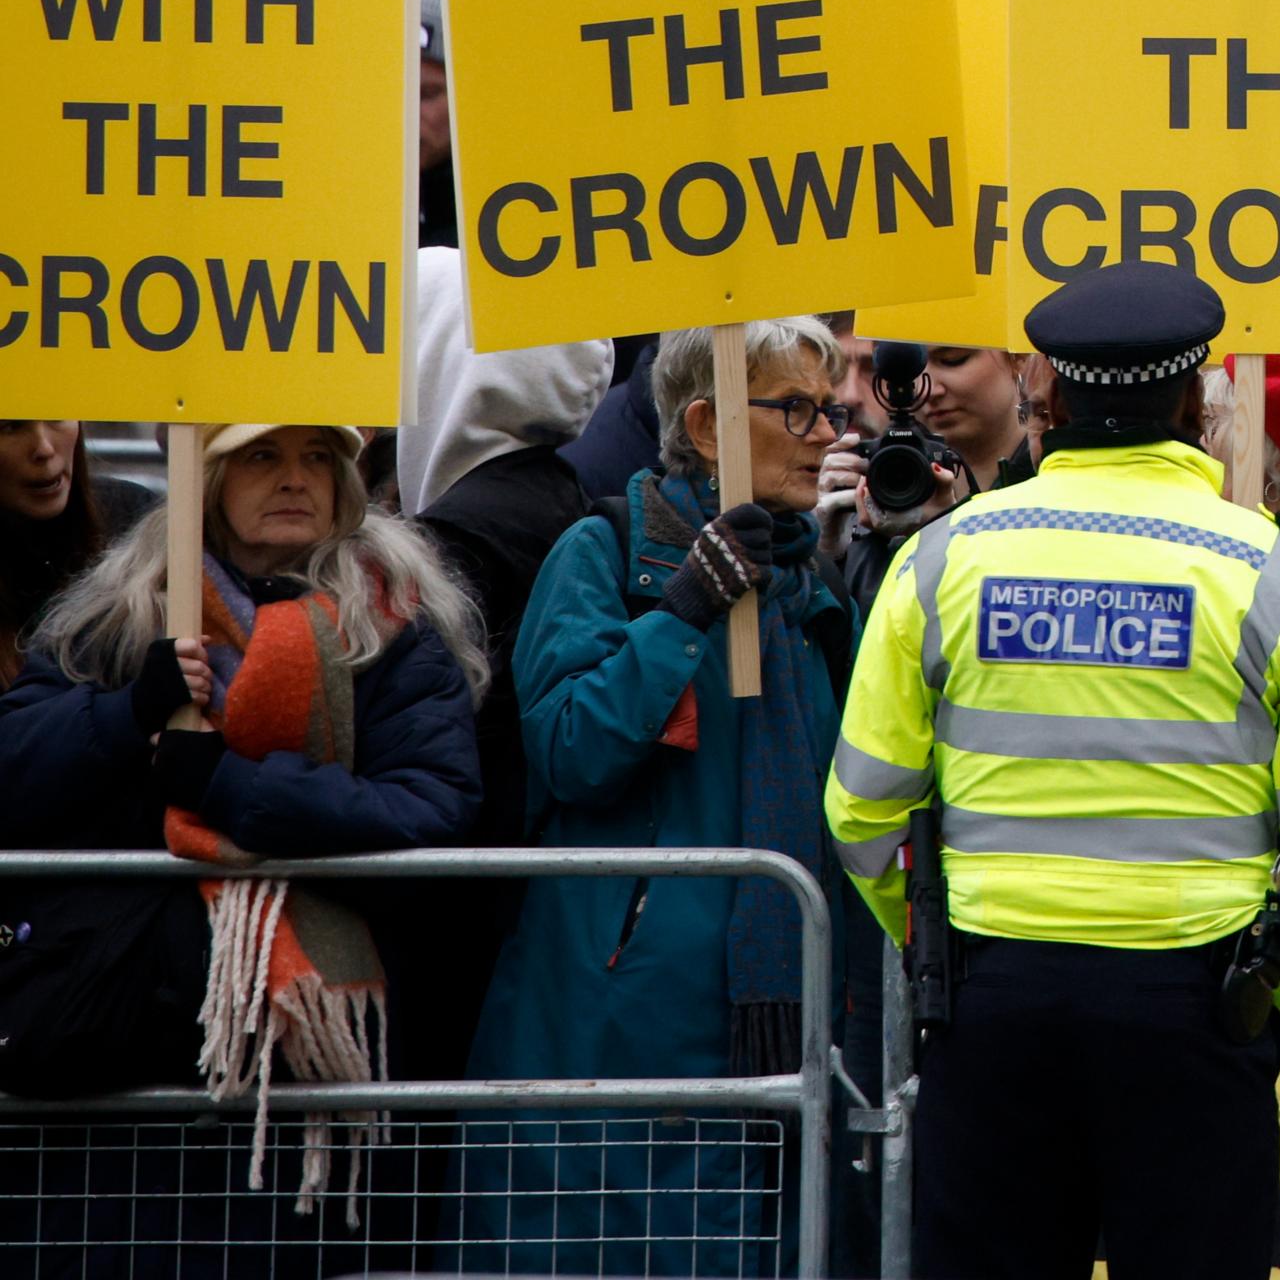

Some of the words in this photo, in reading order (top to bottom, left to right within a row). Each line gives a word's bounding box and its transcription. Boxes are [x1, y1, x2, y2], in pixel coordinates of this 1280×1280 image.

[581, 0, 828, 112] THE
[63, 102, 283, 198] THE
[478, 137, 953, 277] CROWN
[889, 429, 913, 438] Canon
[989, 585, 1185, 614] METROPOLITAN
[986, 612, 1182, 661] POLICE
